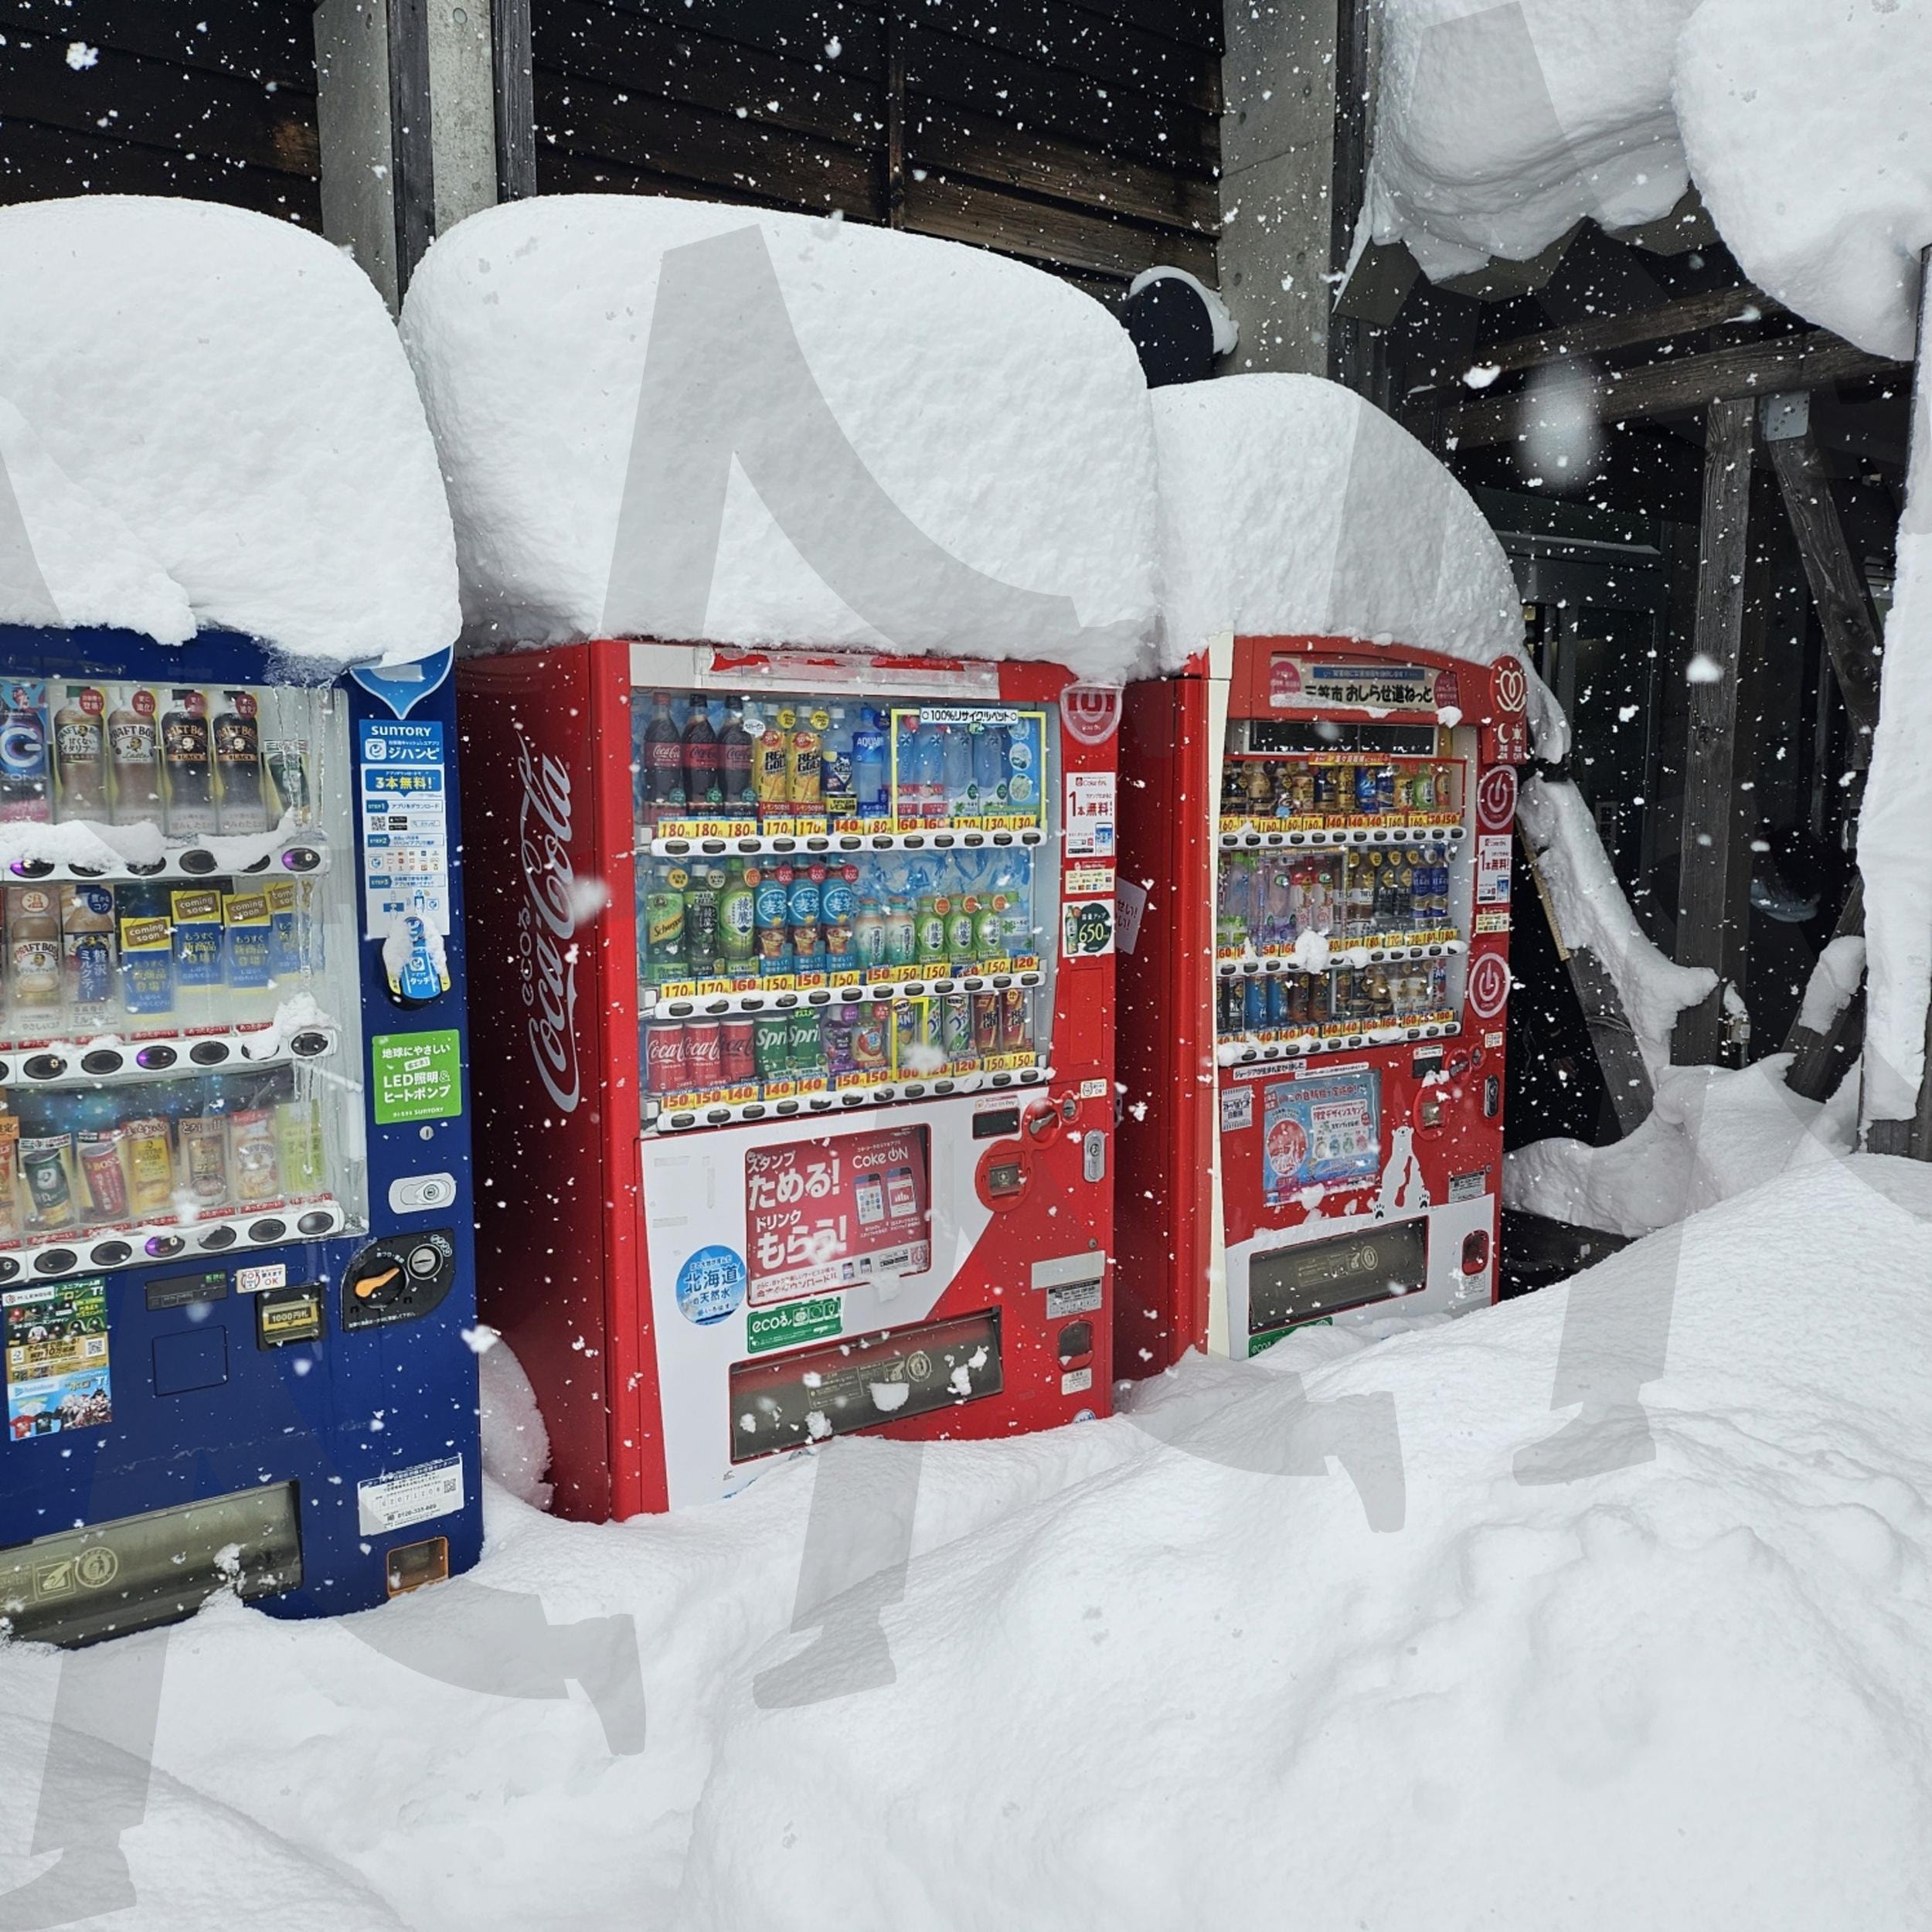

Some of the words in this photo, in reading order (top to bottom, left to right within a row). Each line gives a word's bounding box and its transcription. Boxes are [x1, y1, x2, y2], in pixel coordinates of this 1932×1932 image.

[371, 726, 431, 736] SUNTORY
[179, 896, 214, 909] coming
[129, 923, 165, 936] coming
[136, 932, 161, 941] soon
[80, 949, 94, 999] ミルクティー
[382, 1043, 451, 1059] 地球にやさしい
[383, 1070, 451, 1088] LED照明&
[383, 1084, 451, 1104] ヒートポンプ
[747, 1151, 796, 1174] スタンプ
[852, 1152, 887, 1169] Coke
[748, 1158, 841, 1212] ためる!
[757, 1209, 802, 1233] ドリンク
[757, 1214, 848, 1270] もらう!
[685, 1265, 739, 1294] 北海道
[692, 1288, 731, 1305] の天然水
[272, 1310, 310, 1322] 1000円札
